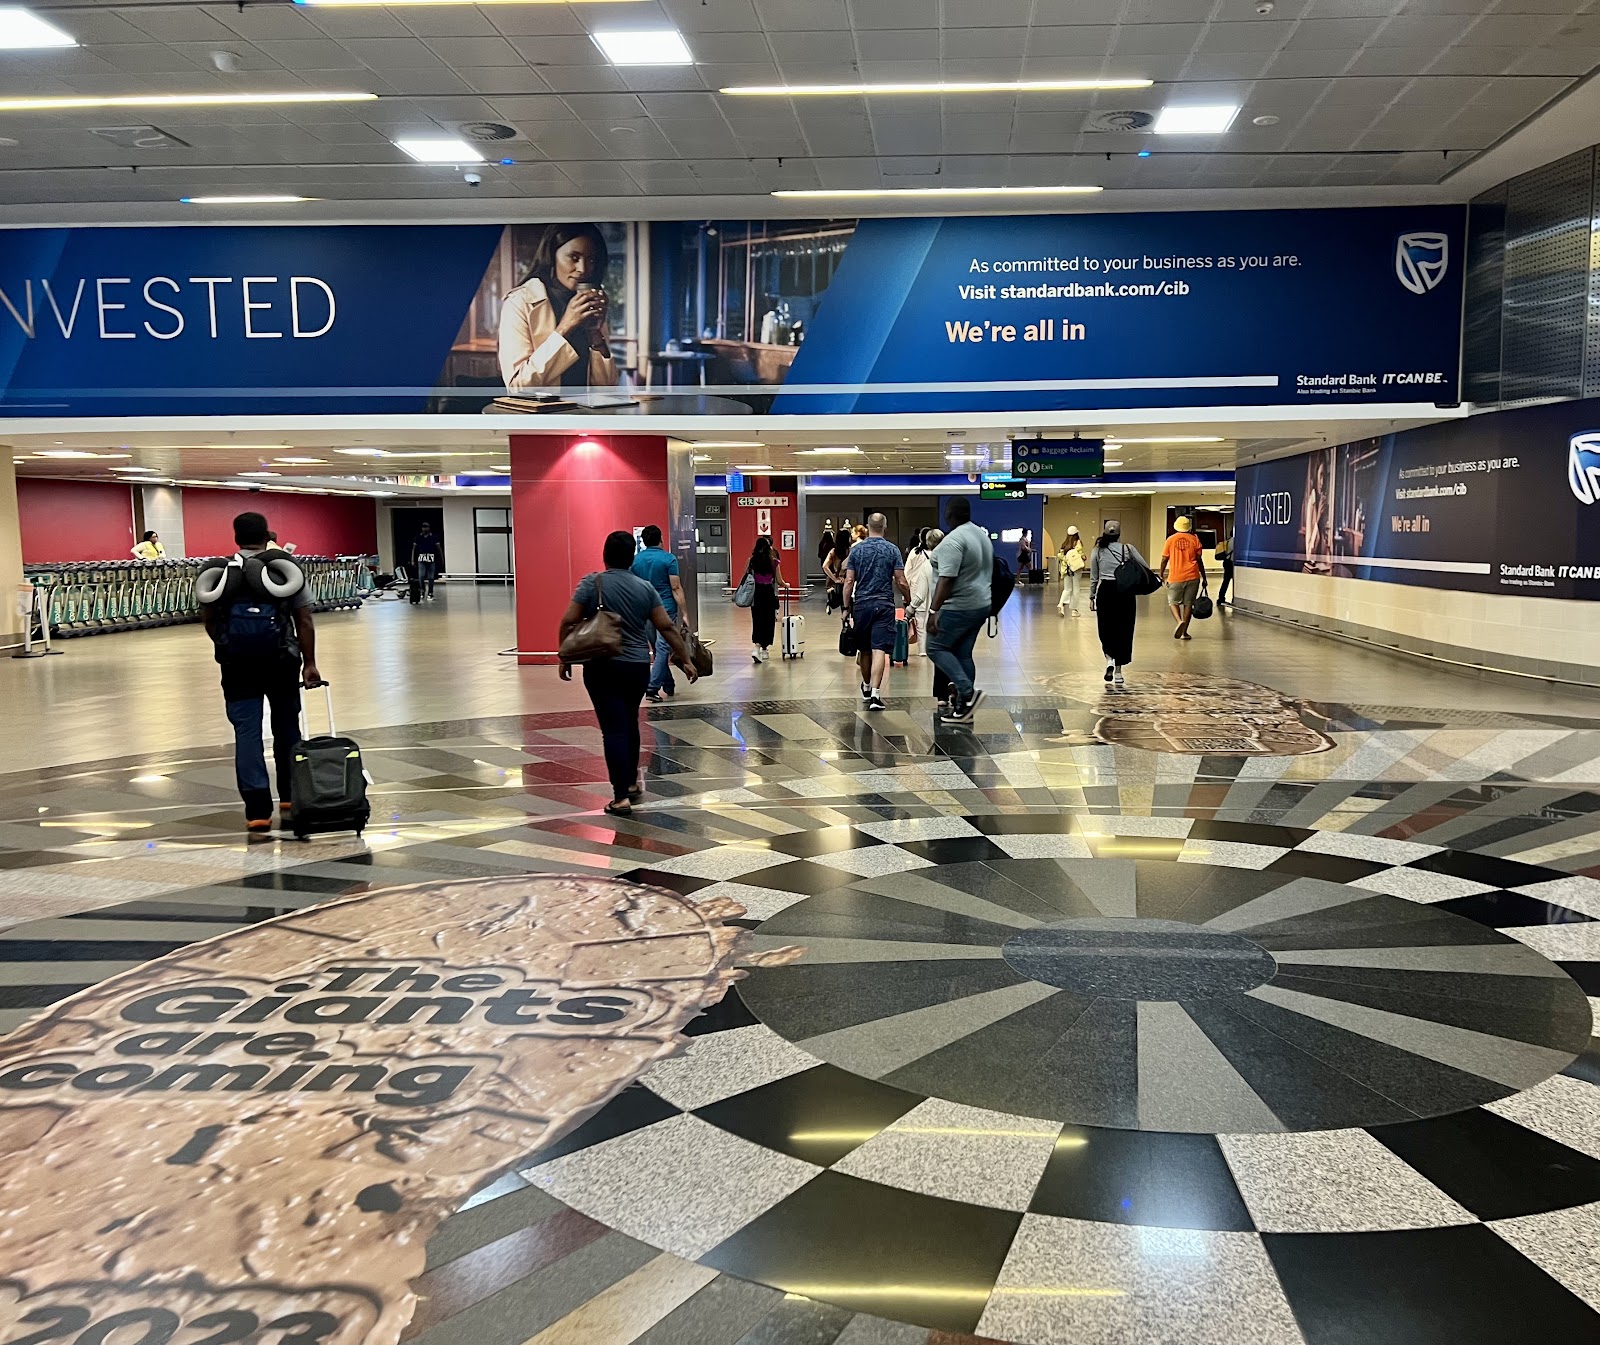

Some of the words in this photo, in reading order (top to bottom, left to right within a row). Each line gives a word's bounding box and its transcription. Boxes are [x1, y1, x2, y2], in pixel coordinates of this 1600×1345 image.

[969, 258, 989, 273] As
[993, 256, 1079, 272] committed
[1083, 257, 1099, 271] to
[1103, 257, 1138, 274] your
[1143, 254, 1212, 270] business
[1217, 257, 1235, 269] as
[1239, 256, 1268, 271] you
[1272, 255, 1302, 268] are.
[958, 284, 996, 300] Visit
[1000, 281, 1189, 299] standardbank.com/cib
[945, 320, 1017, 343] We're
[1023, 319, 1054, 341] all
[1062, 318, 1086, 341] in
[1296, 374, 1347, 386] Standard
[1349, 374, 1377, 385] Bank
[1041, 447, 1068, 455] Baggage
[1435, 465, 1447, 478] your
[1448, 460, 1476, 474] business
[1478, 461, 1486, 471] as
[1487, 458, 1501, 473] you
[1502, 457, 1520, 469] are.
[1395, 488, 1406, 499] Visit
[1406, 483, 1467, 498] standardbank.com/cib
[1244, 491, 1292, 525] INVESTED
[1411, 515, 1421, 532] all
[1421, 515, 1430, 532] in
[1500, 564, 1534, 576] Standard
[1535, 565, 1555, 577] Bank
[320, 966, 503, 993] The
[119, 982, 635, 1026] Giants
[114, 1031, 316, 1057] are
[1, 1051, 477, 1106] coming
